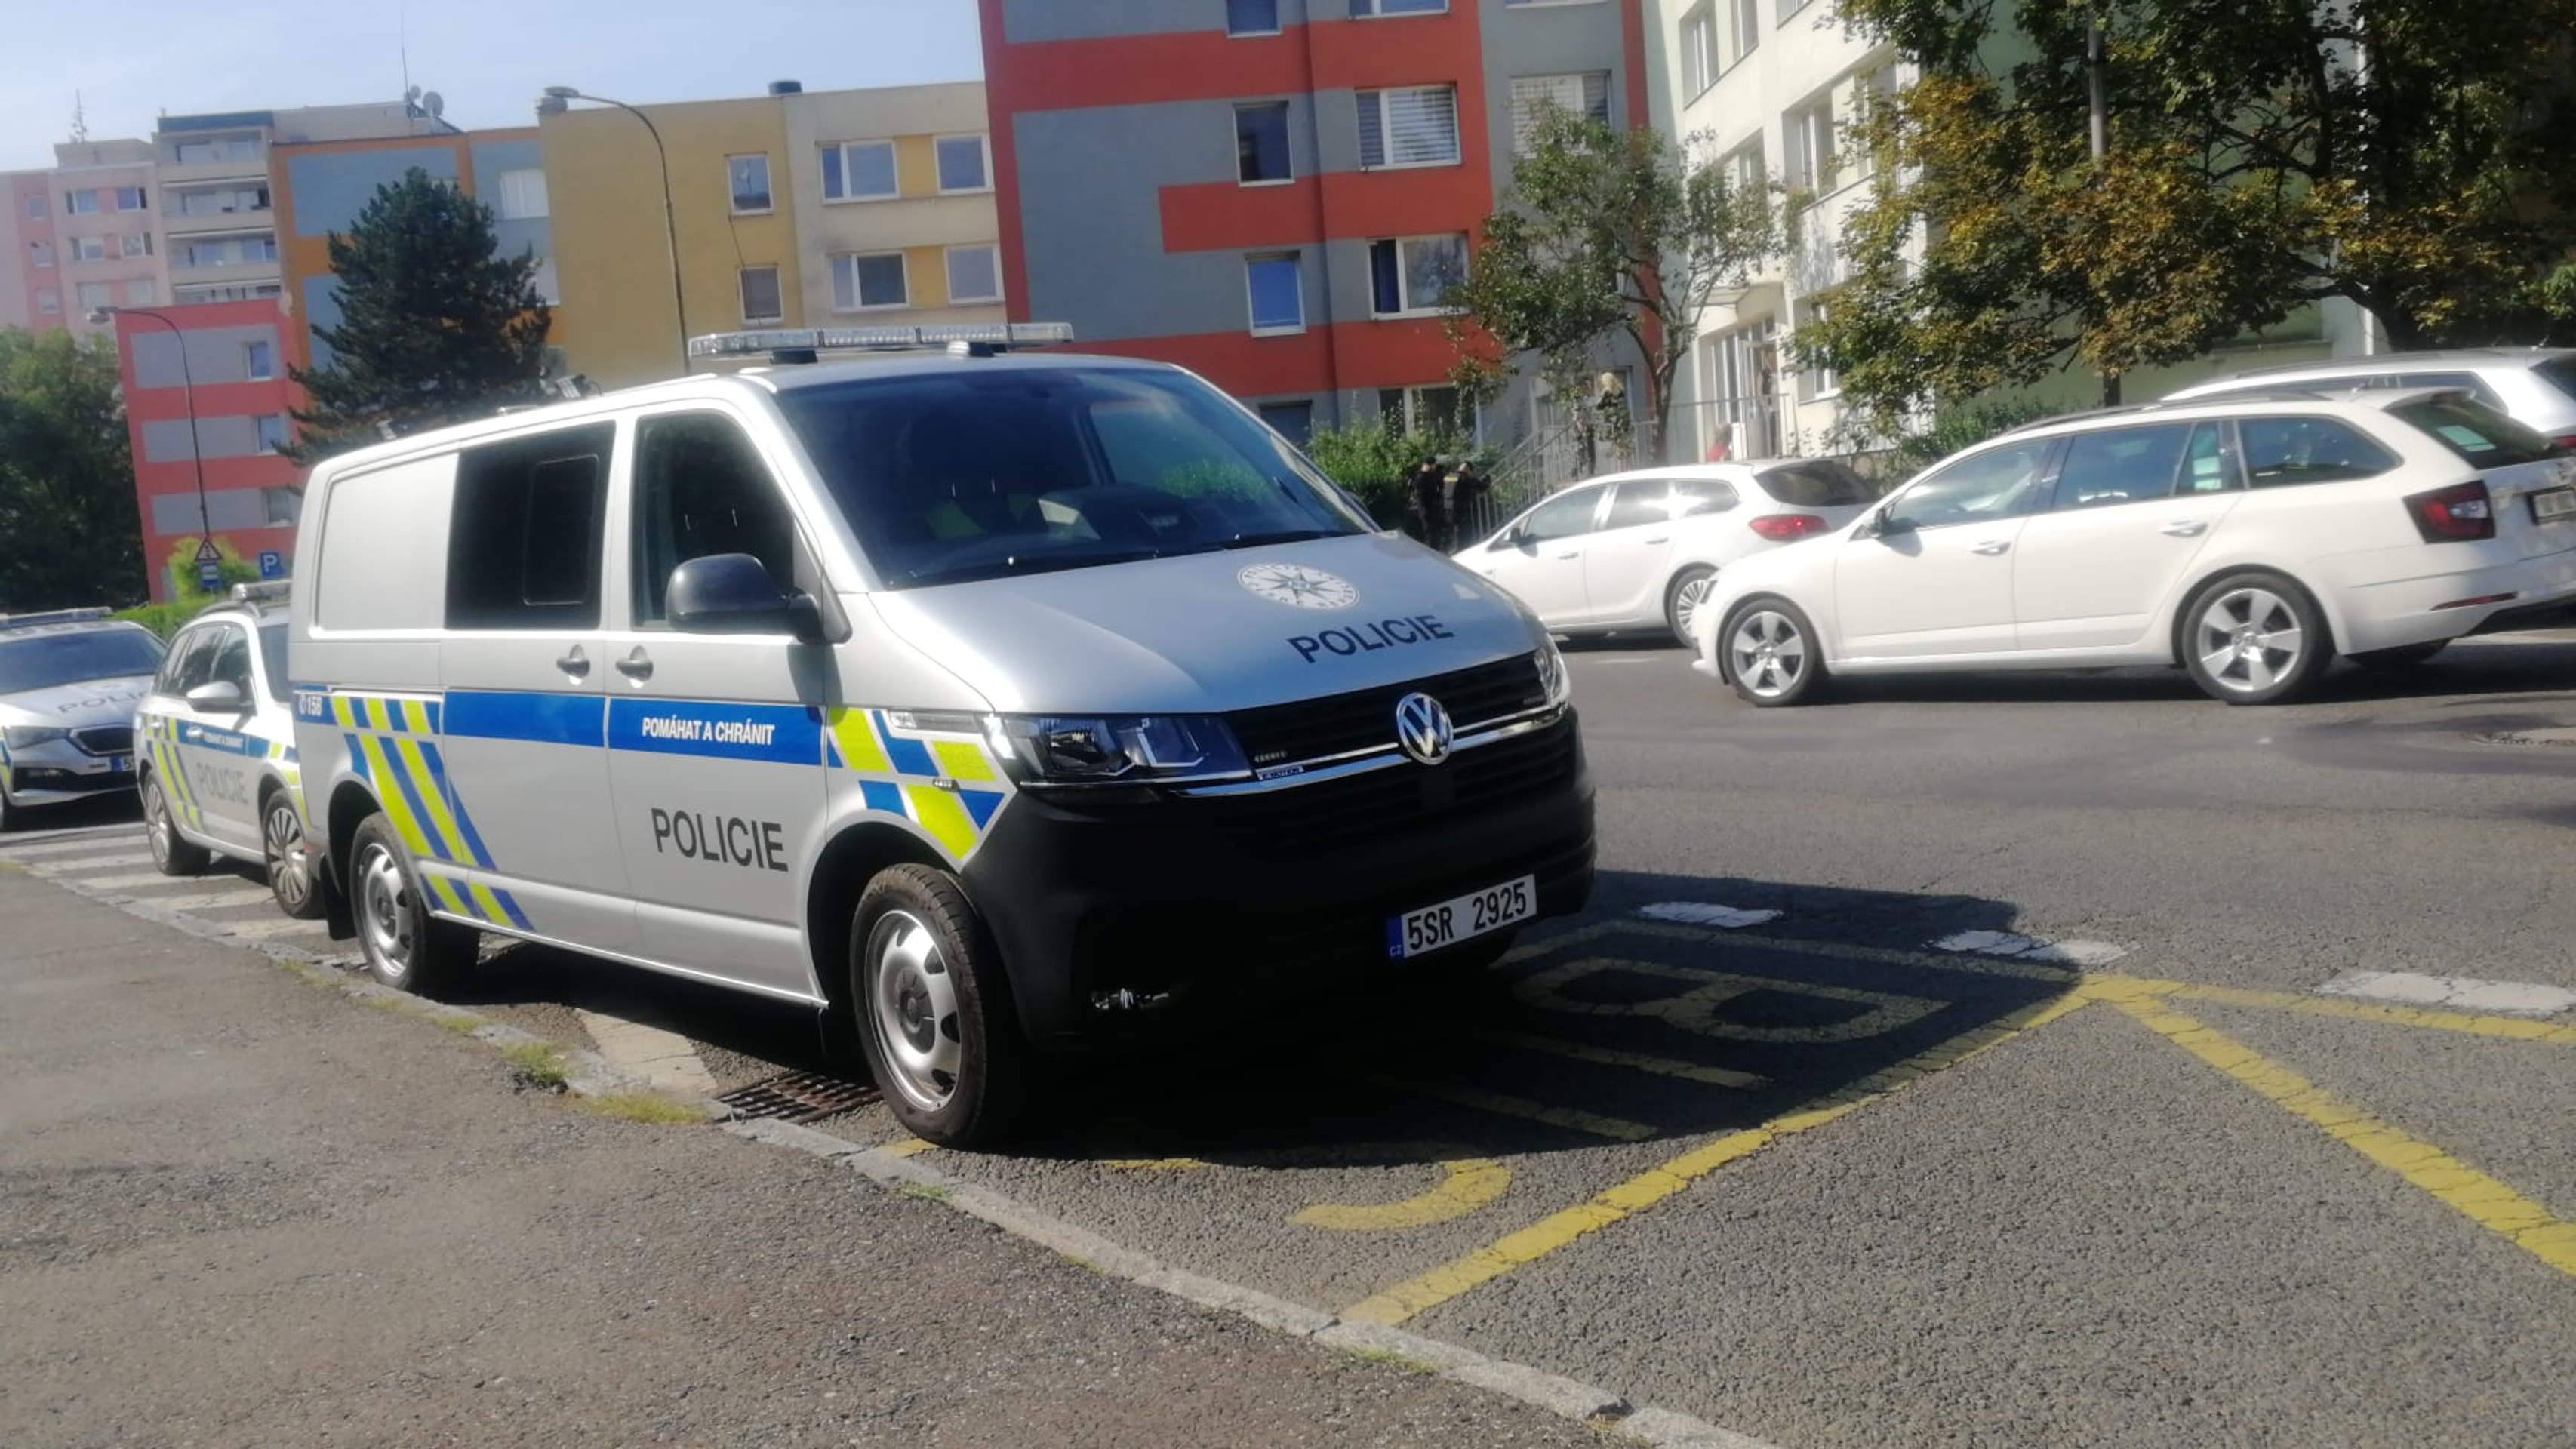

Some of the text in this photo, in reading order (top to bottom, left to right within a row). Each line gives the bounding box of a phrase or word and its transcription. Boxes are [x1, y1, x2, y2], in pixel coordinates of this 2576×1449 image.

[263, 554, 278, 573] P
[1287, 614, 1455, 664] POLICIE
[57, 690, 150, 712] POLI
[642, 715, 775, 745] POMÁHAT A CHRÁNIT
[651, 808, 789, 872] POLICIE
[1390, 881, 1527, 956] CZ 5SR 2925
